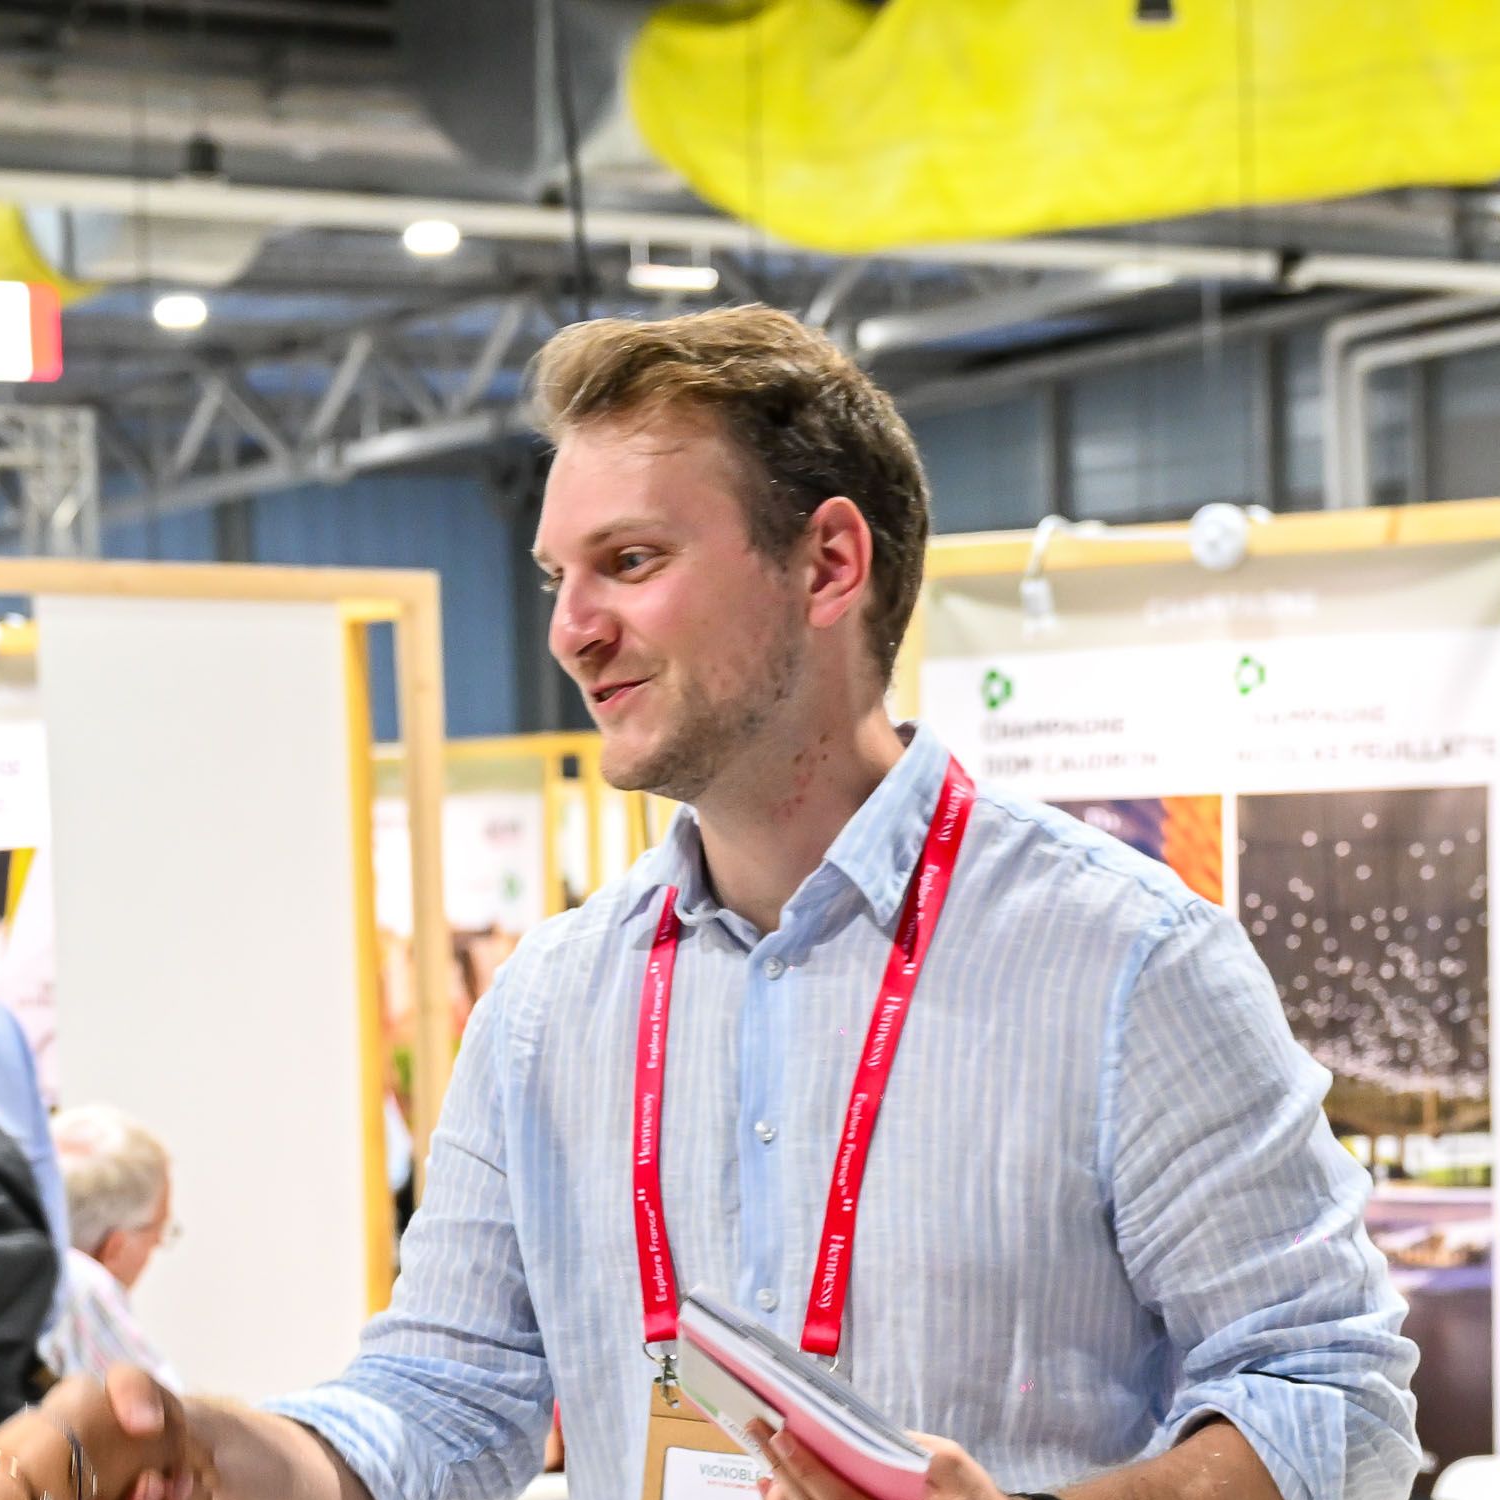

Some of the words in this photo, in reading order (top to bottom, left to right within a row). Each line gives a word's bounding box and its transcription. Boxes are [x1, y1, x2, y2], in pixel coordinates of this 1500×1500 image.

[646, 1021, 661, 1069] Explore
[652, 1253, 669, 1303] Explore
[816, 1234, 847, 1312] Hennessy
